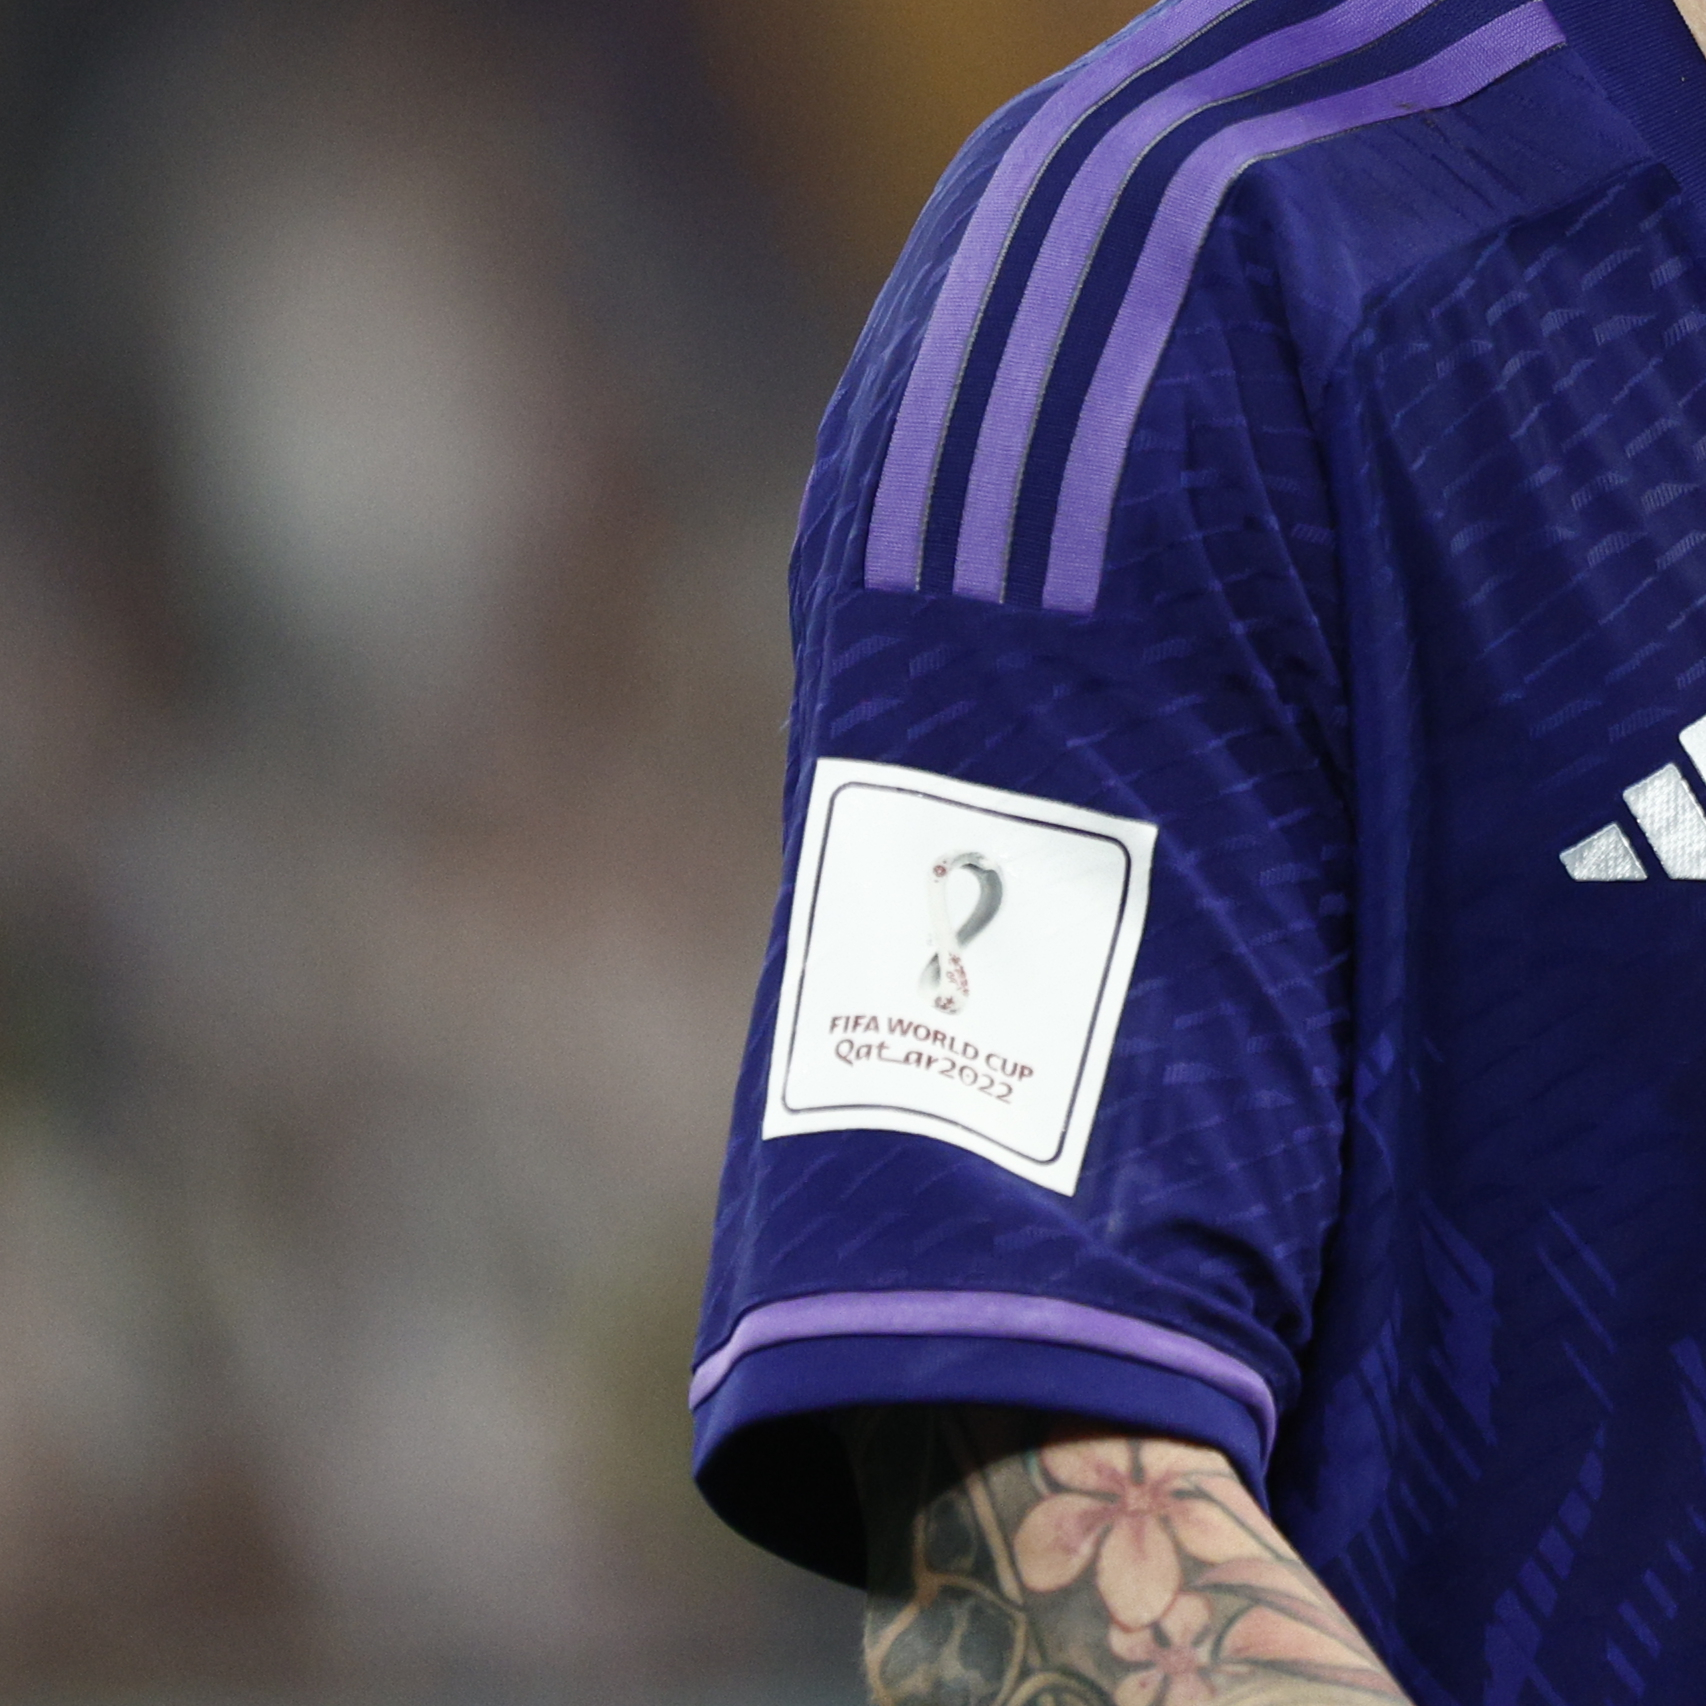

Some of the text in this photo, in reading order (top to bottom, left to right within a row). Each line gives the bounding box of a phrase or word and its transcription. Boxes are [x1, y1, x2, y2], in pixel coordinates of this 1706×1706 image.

[829, 1015, 1034, 1082] FIFA WORLD CUP
